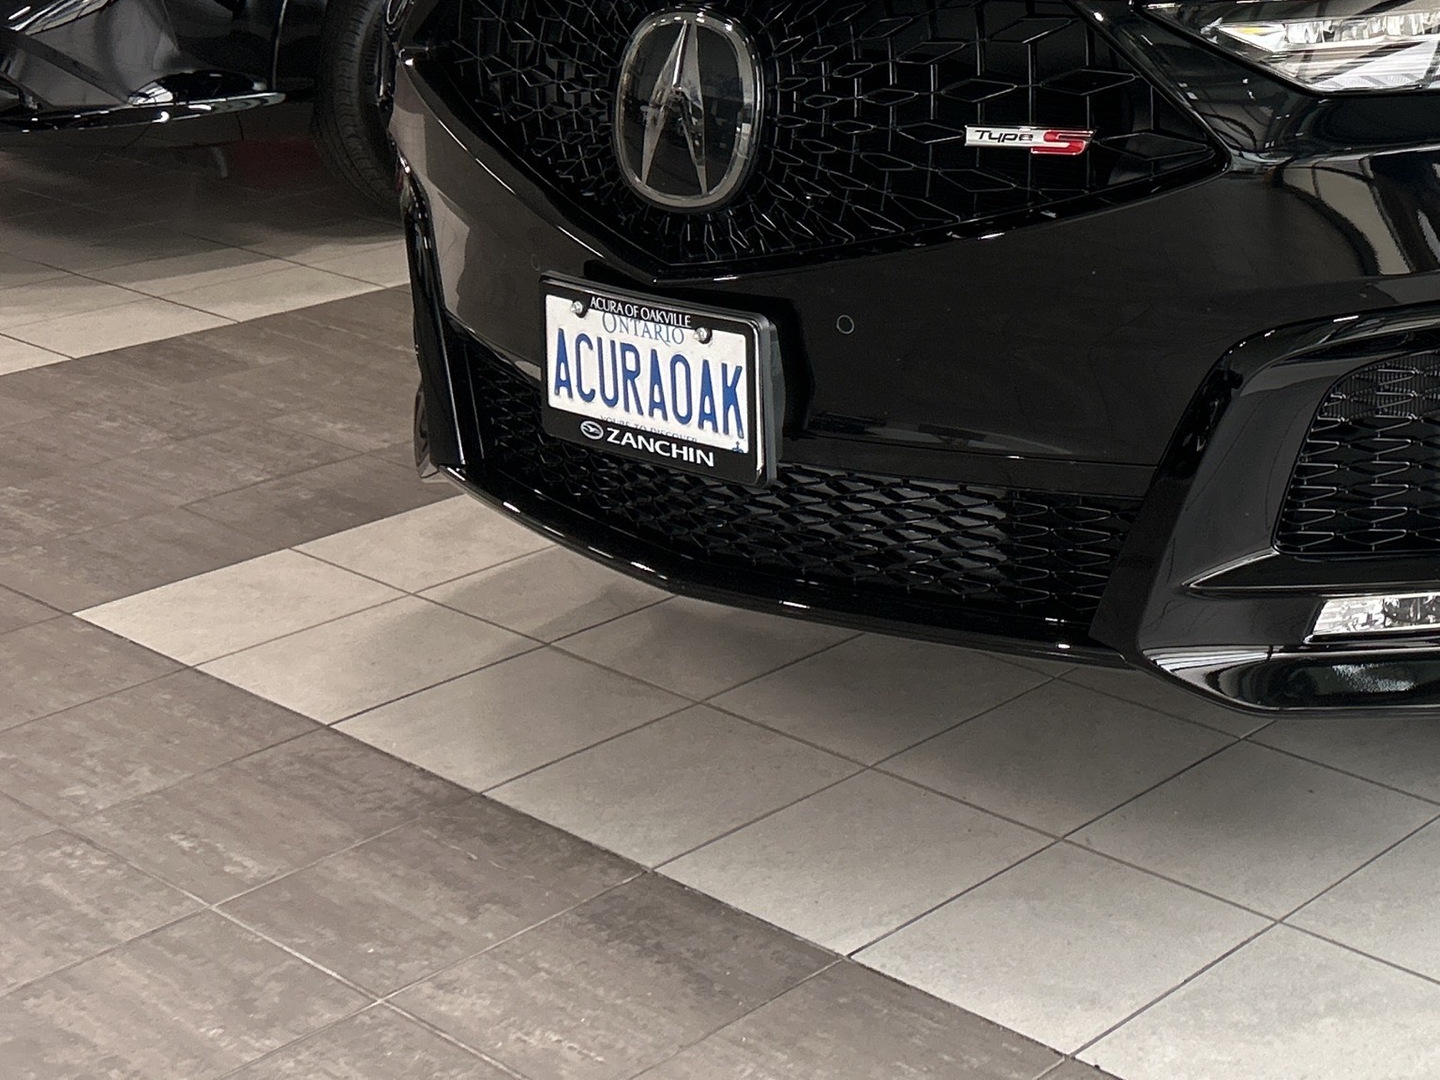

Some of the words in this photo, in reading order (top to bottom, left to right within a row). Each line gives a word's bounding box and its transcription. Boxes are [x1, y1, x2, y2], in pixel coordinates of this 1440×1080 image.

[590, 296, 624, 315] ACURA
[624, 304, 640, 318] OF
[640, 307, 692, 328] OAKVILLE
[602, 311, 685, 348] ONTARIO
[553, 327, 744, 439] ACURAOAK
[606, 427, 715, 467] ZANCHIN
